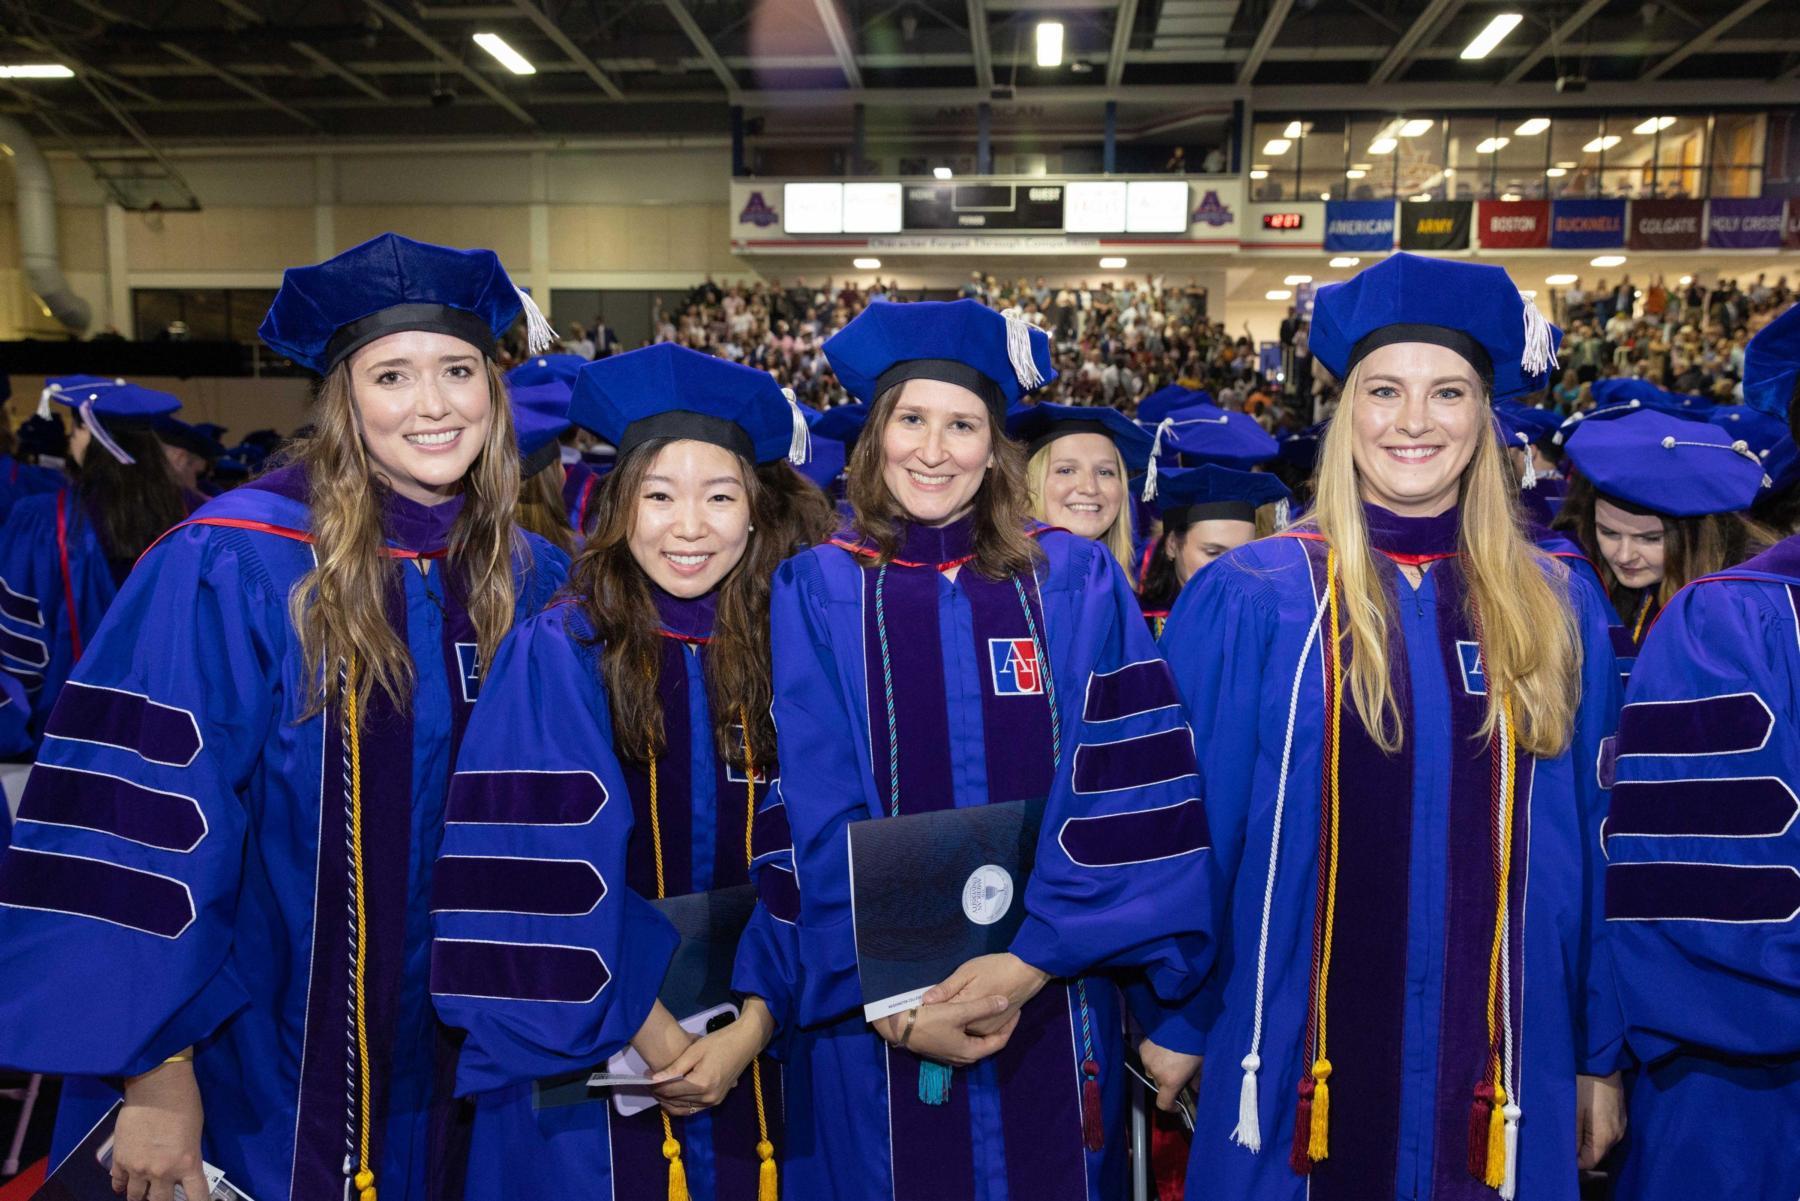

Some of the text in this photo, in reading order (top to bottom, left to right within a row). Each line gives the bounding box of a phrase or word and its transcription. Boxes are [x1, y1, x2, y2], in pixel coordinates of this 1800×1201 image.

[1328, 218, 1393, 235] AMERICAN
[1417, 218, 1454, 234] ARMY
[1490, 216, 1536, 232] BOSTON
[1555, 216, 1620, 232] BUCKNELL
[1639, 217, 1697, 234] COLGATE
[999, 640, 1036, 693] AU
